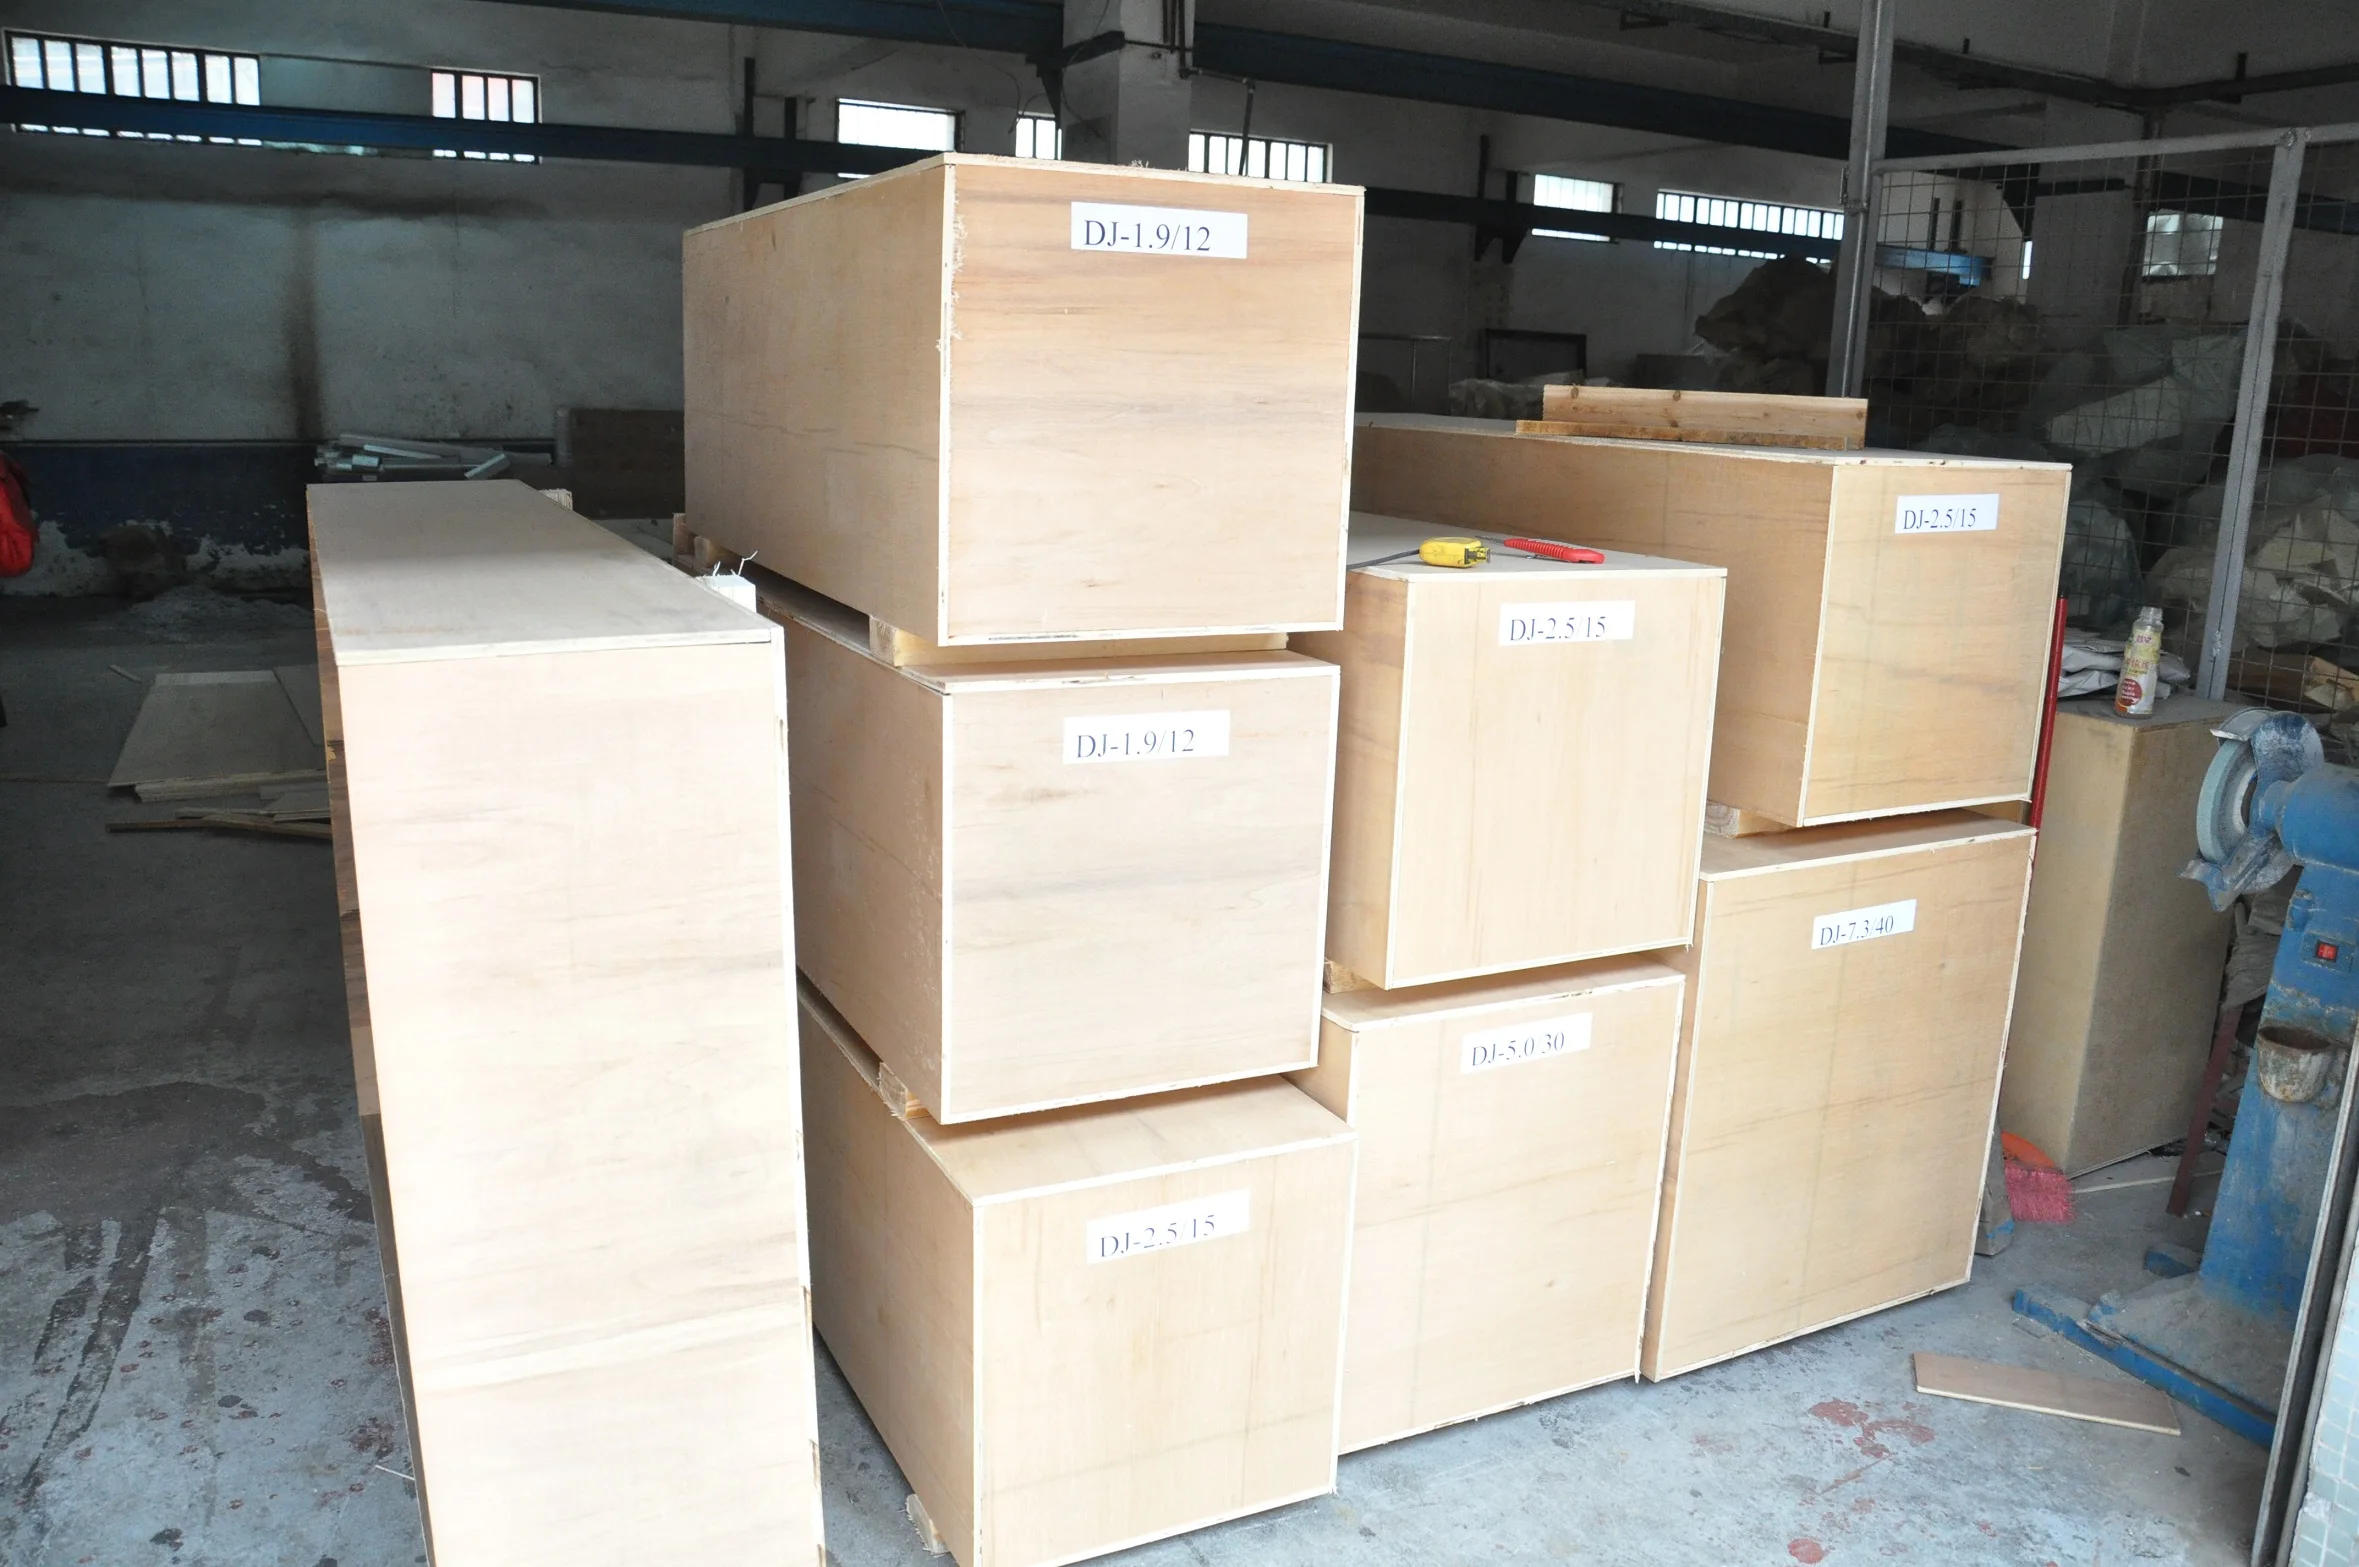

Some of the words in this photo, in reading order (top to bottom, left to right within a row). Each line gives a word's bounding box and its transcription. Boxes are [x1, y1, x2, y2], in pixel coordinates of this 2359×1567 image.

[1083, 219, 1211, 251] DJ-1.9/12
[1903, 508, 1977, 530] DJ-2.5/15
[1510, 615, 1606, 641] DJ-2.5/15
[1076, 728, 1195, 758] DJ-1.9/12
[1820, 915, 1894, 945] DJ-7.3/40
[1101, 1214, 1215, 1257] DJ-2.5/15
